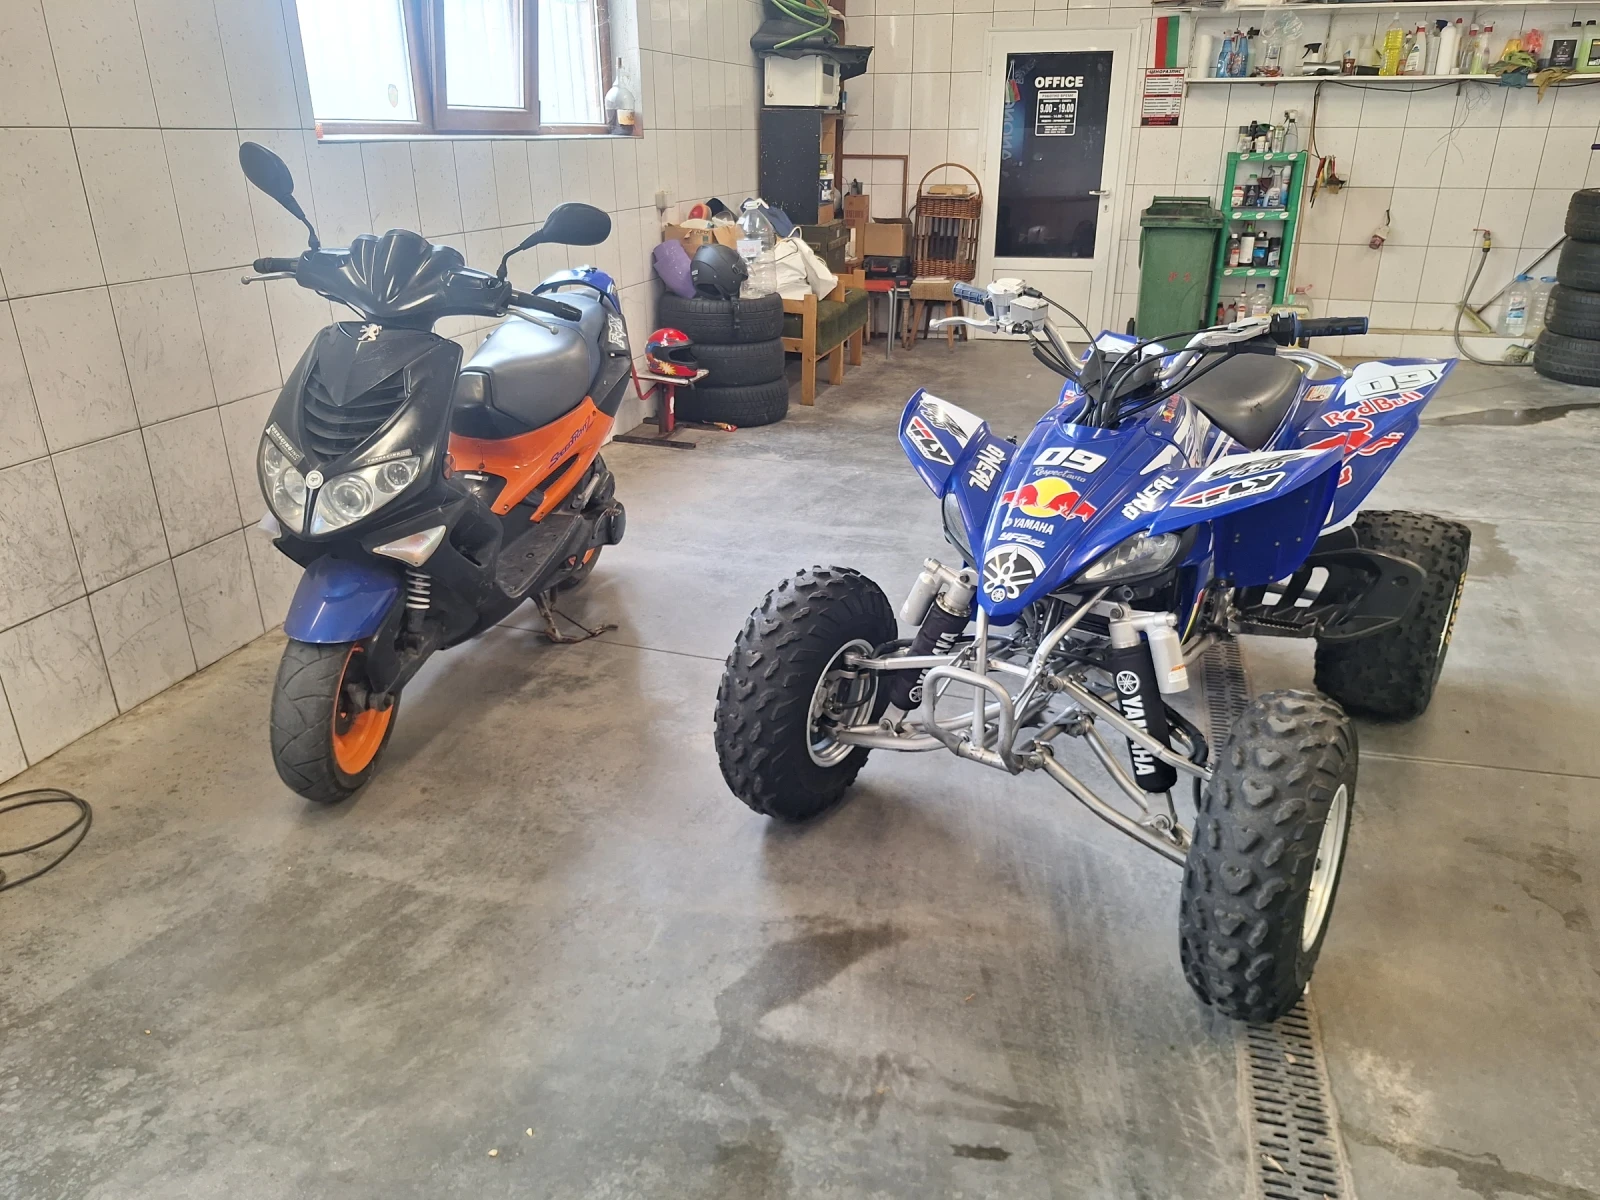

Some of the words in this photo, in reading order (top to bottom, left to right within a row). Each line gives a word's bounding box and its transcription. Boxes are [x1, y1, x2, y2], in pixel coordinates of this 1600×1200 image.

[1034, 76, 1084, 88] OFFICE
[1058, 103, 1075, 113] 19.00
[1355, 369, 1437, 396] 09
[1033, 447, 1107, 474] 09
[1013, 518, 1055, 535] YAMAHA
